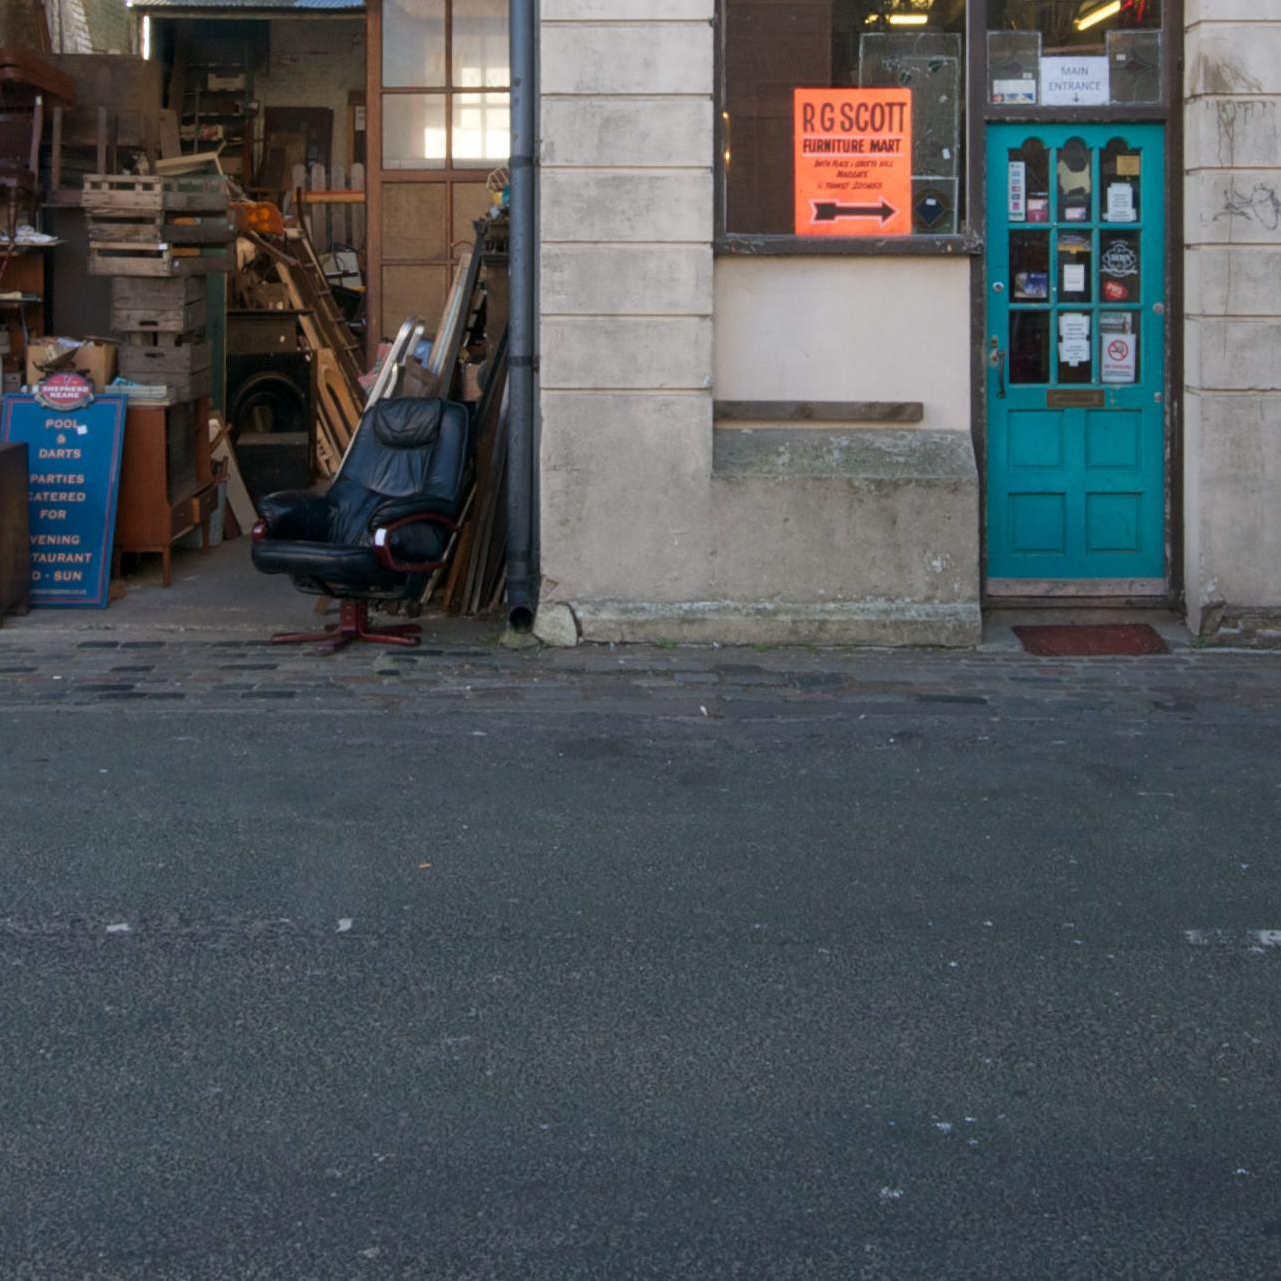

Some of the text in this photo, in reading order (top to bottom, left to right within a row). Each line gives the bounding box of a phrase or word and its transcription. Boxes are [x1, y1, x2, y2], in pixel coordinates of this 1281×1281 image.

[1061, 66, 1089, 76] MAIN
[1048, 81, 1101, 92] ENTRANCE
[802, 102, 907, 132] R G SCOTT
[803, 139, 902, 153] FURNITURE MART
[41, 385, 89, 393] SHEPHERD
[45, 419, 79, 429] POOL
[39, 448, 81, 459] DARTS
[30, 474, 85, 484] PARTIES
[40, 509, 67, 520] FOR
[30, 535, 81, 545] VENING
[32, 552, 93, 563] TAURANT
[54, 570, 82, 581] SUN
